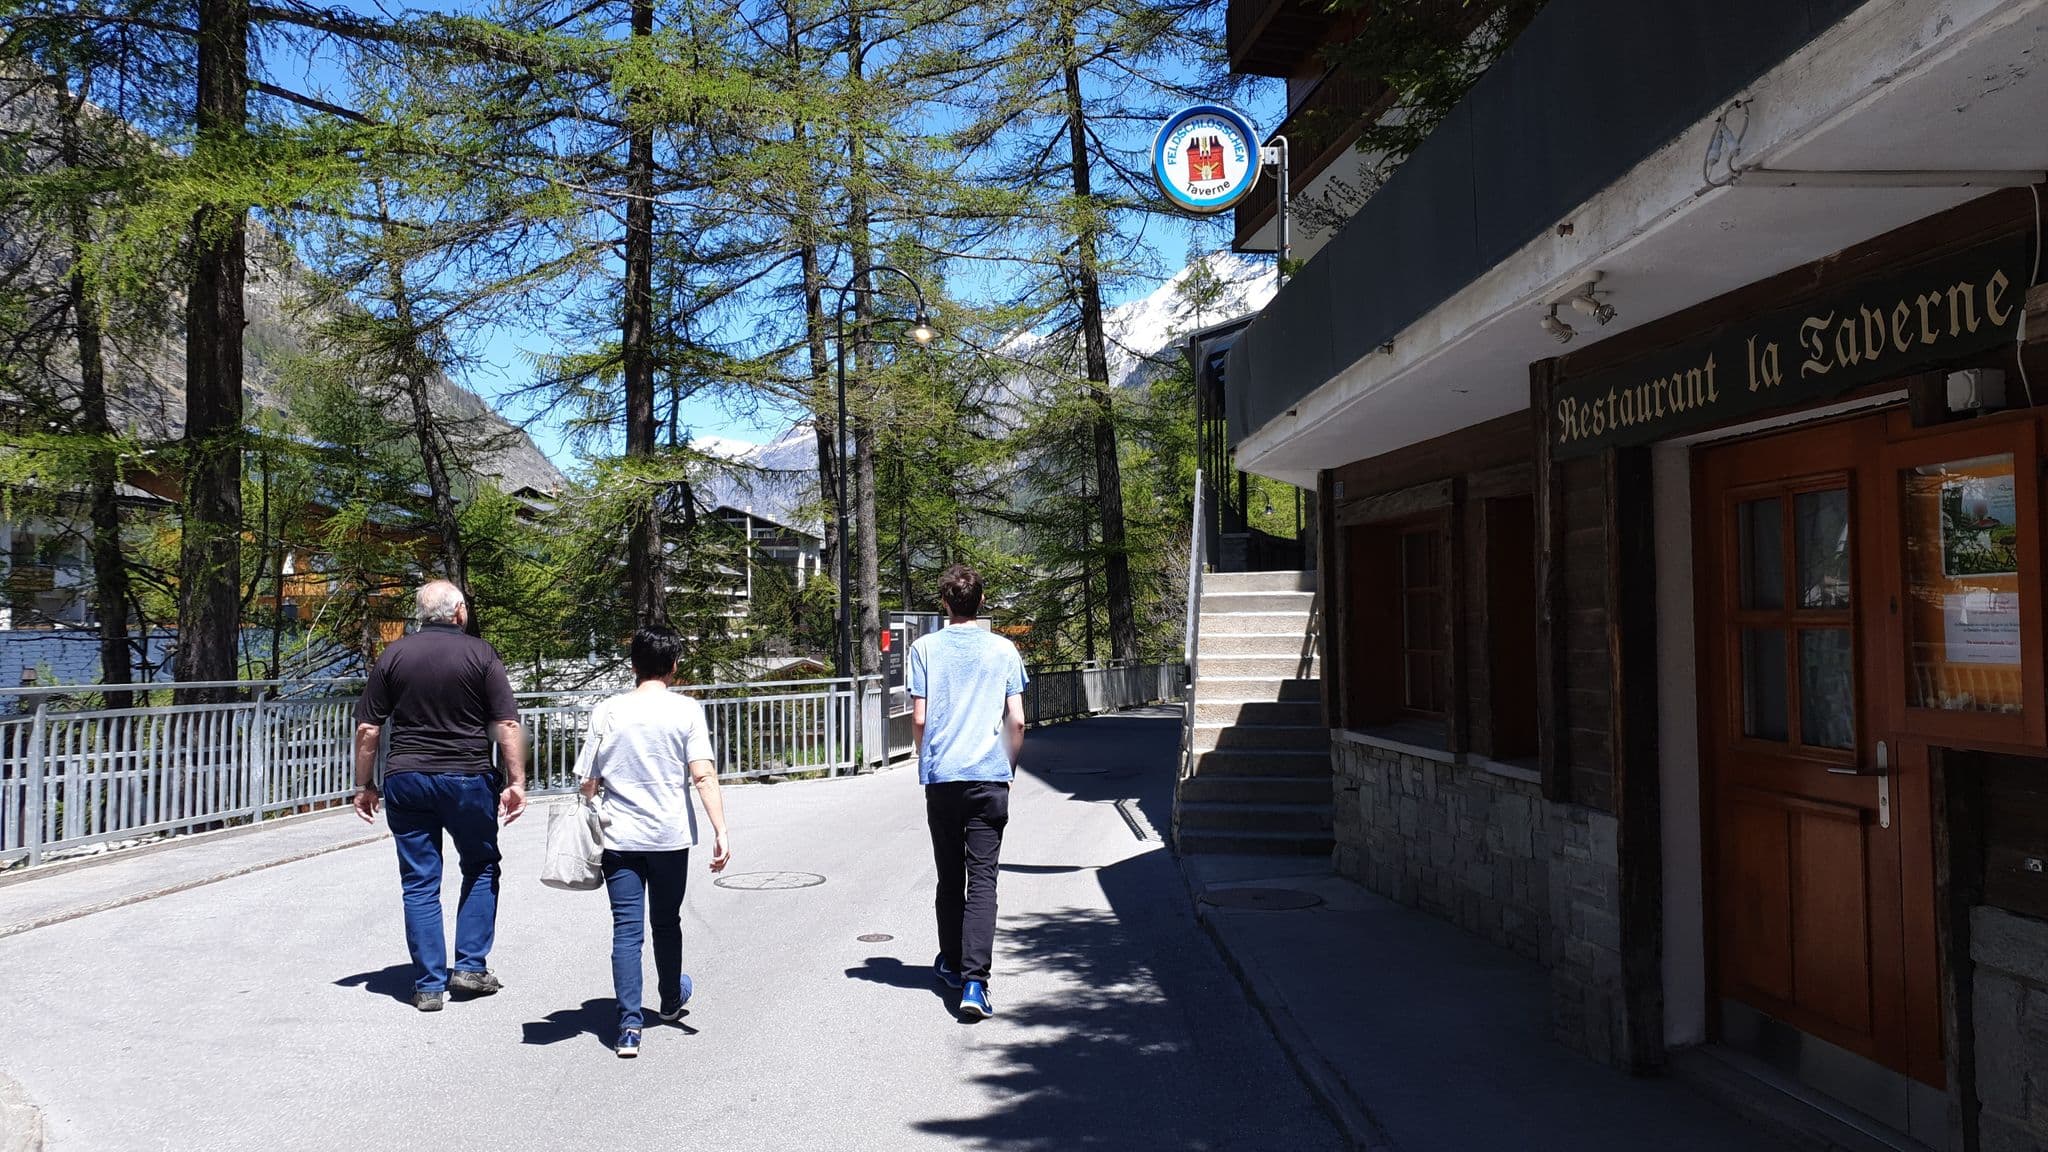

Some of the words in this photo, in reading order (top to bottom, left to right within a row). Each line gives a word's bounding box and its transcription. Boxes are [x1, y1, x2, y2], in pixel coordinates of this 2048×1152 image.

[1185, 180, 1231, 197] Taverne
[1557, 351, 1720, 446] Restaurant
[1746, 333, 1783, 393] la
[1799, 269, 2014, 379] Taverne
